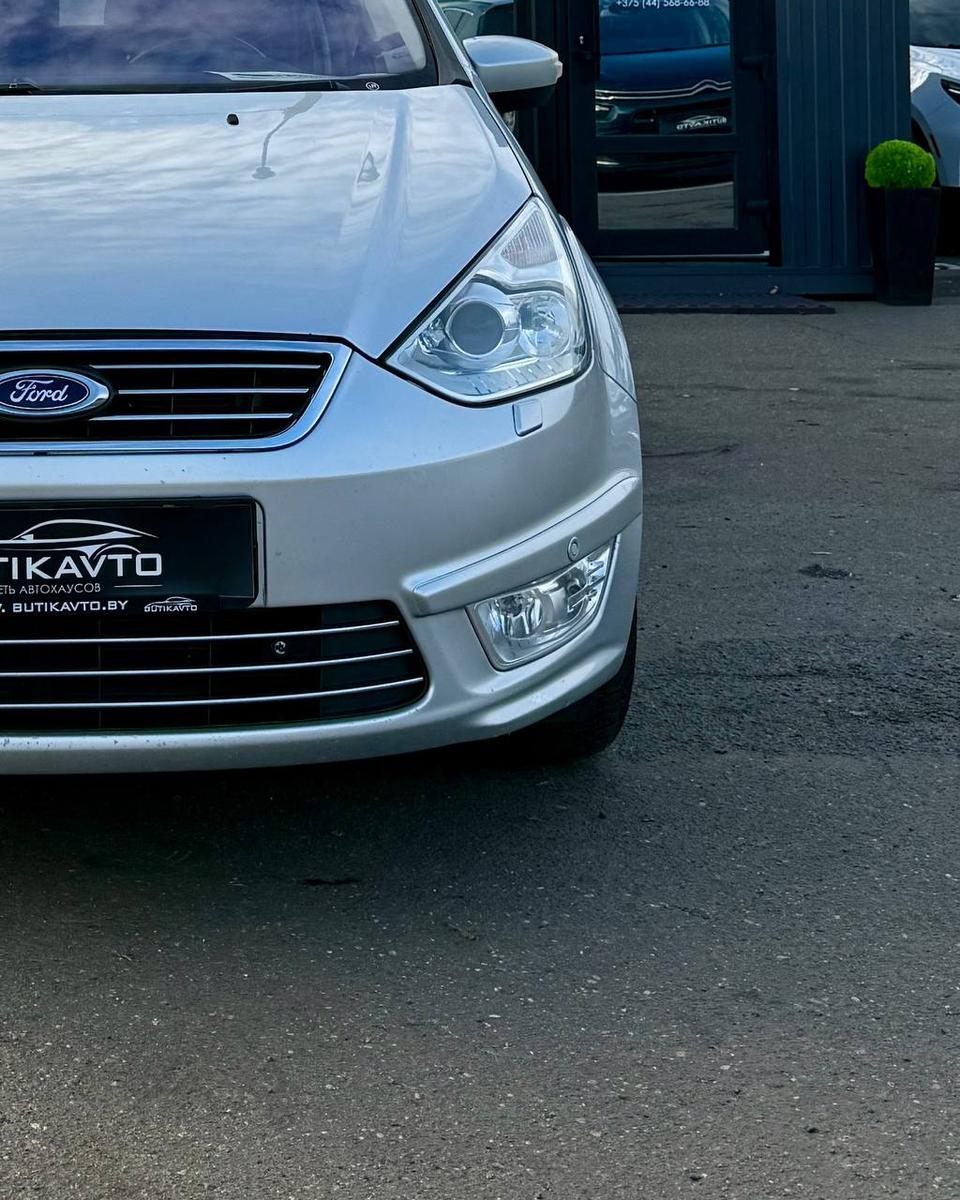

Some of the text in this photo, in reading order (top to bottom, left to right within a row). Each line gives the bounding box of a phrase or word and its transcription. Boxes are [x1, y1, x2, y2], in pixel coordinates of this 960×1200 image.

[9, 379, 69, 403] Ford
[19, 582, 101, 594] АВТОХАУСОВ
[12, 600, 129, 613] BUTIKAVTO.BY
[144, 604, 198, 613] BUTIKAVTO
